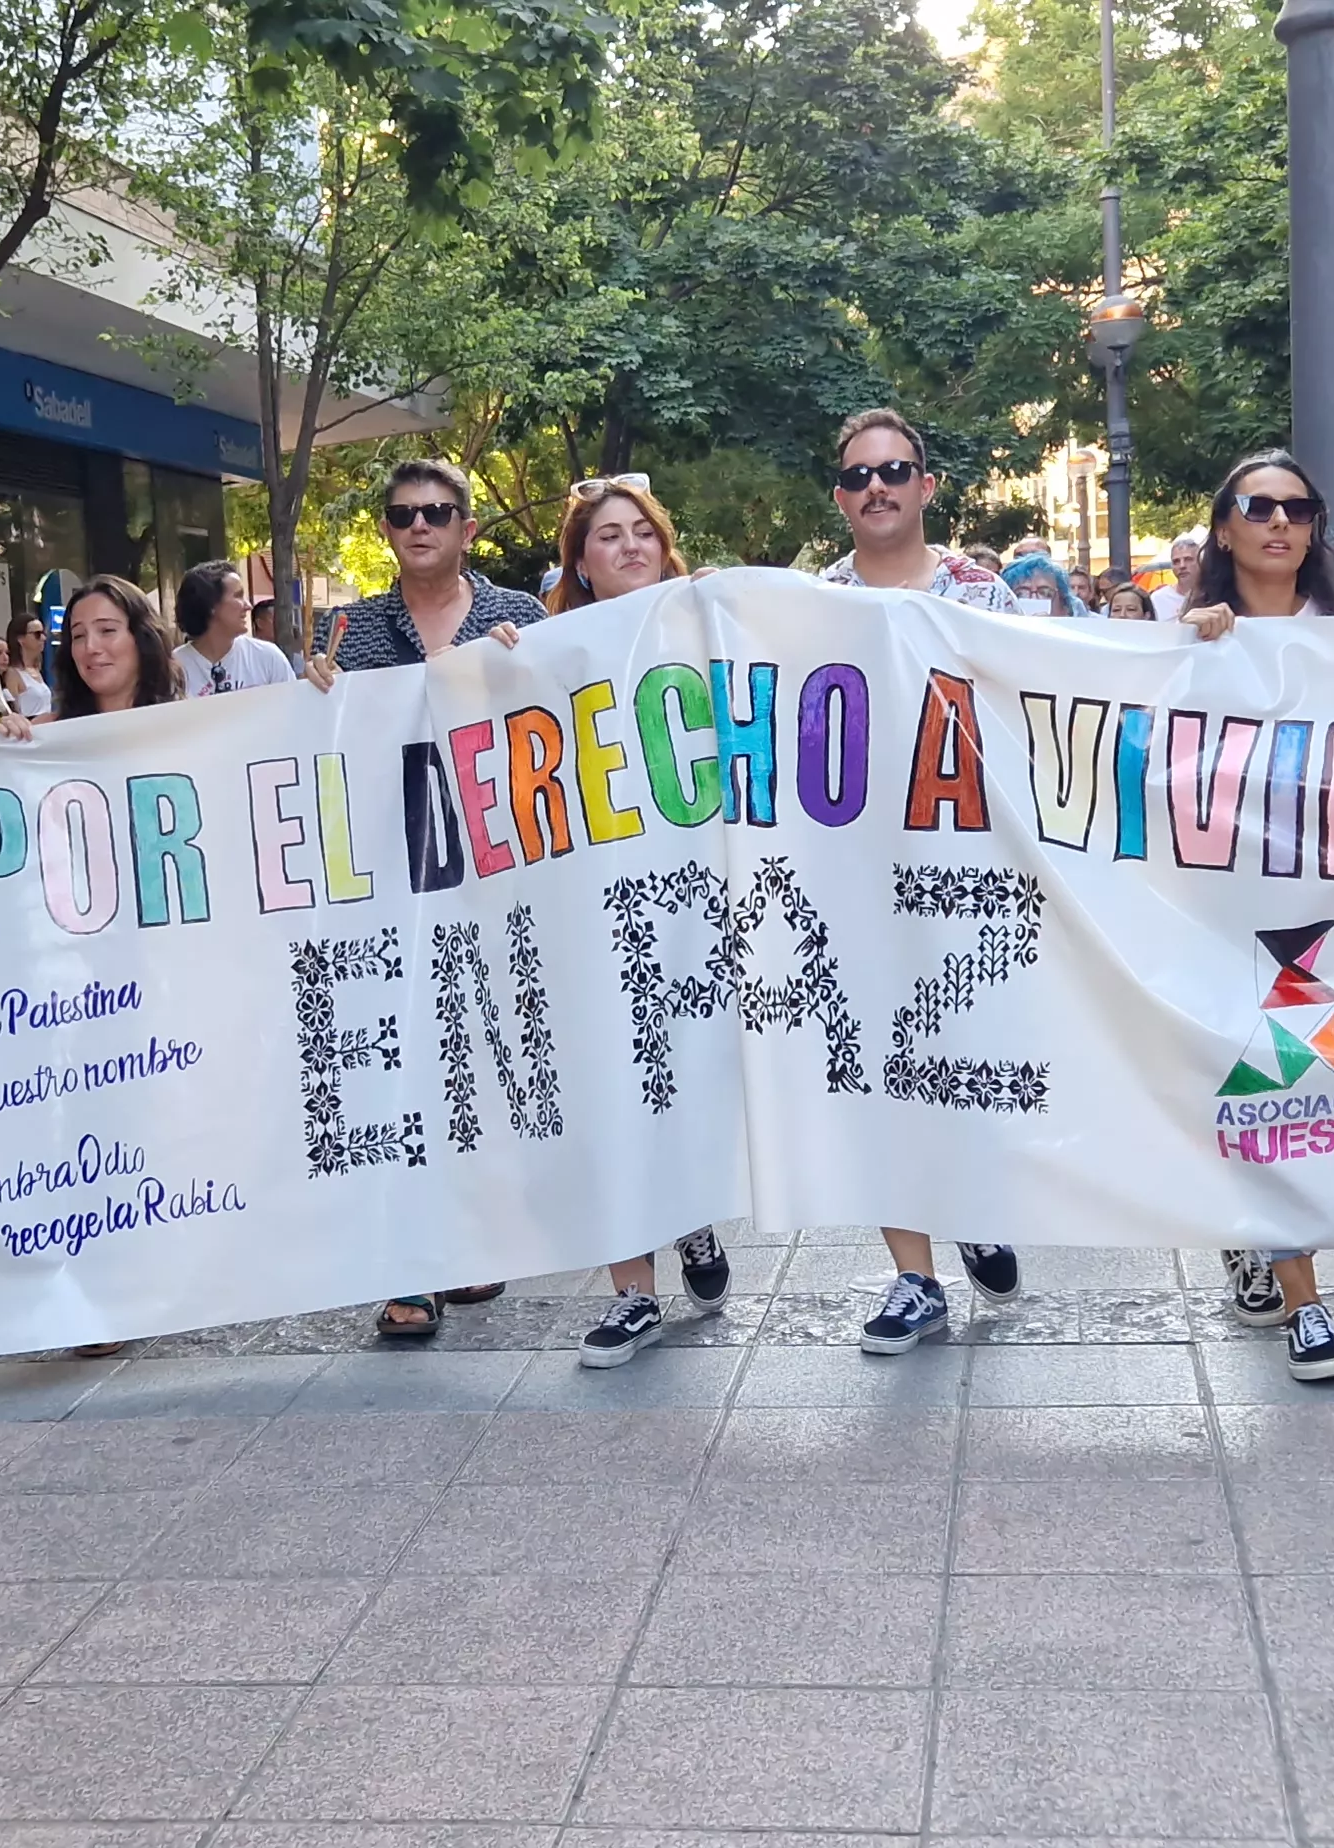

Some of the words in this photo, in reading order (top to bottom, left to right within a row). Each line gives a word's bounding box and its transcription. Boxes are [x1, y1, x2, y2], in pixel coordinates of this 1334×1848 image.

[34, 385, 92, 429] Sabadell
[245, 751, 374, 914] EL
[402, 658, 871, 896] DERECHO
[902, 667, 993, 833] A
[288, 901, 566, 1180] EN
[602, 855, 1052, 1116] PAZ
